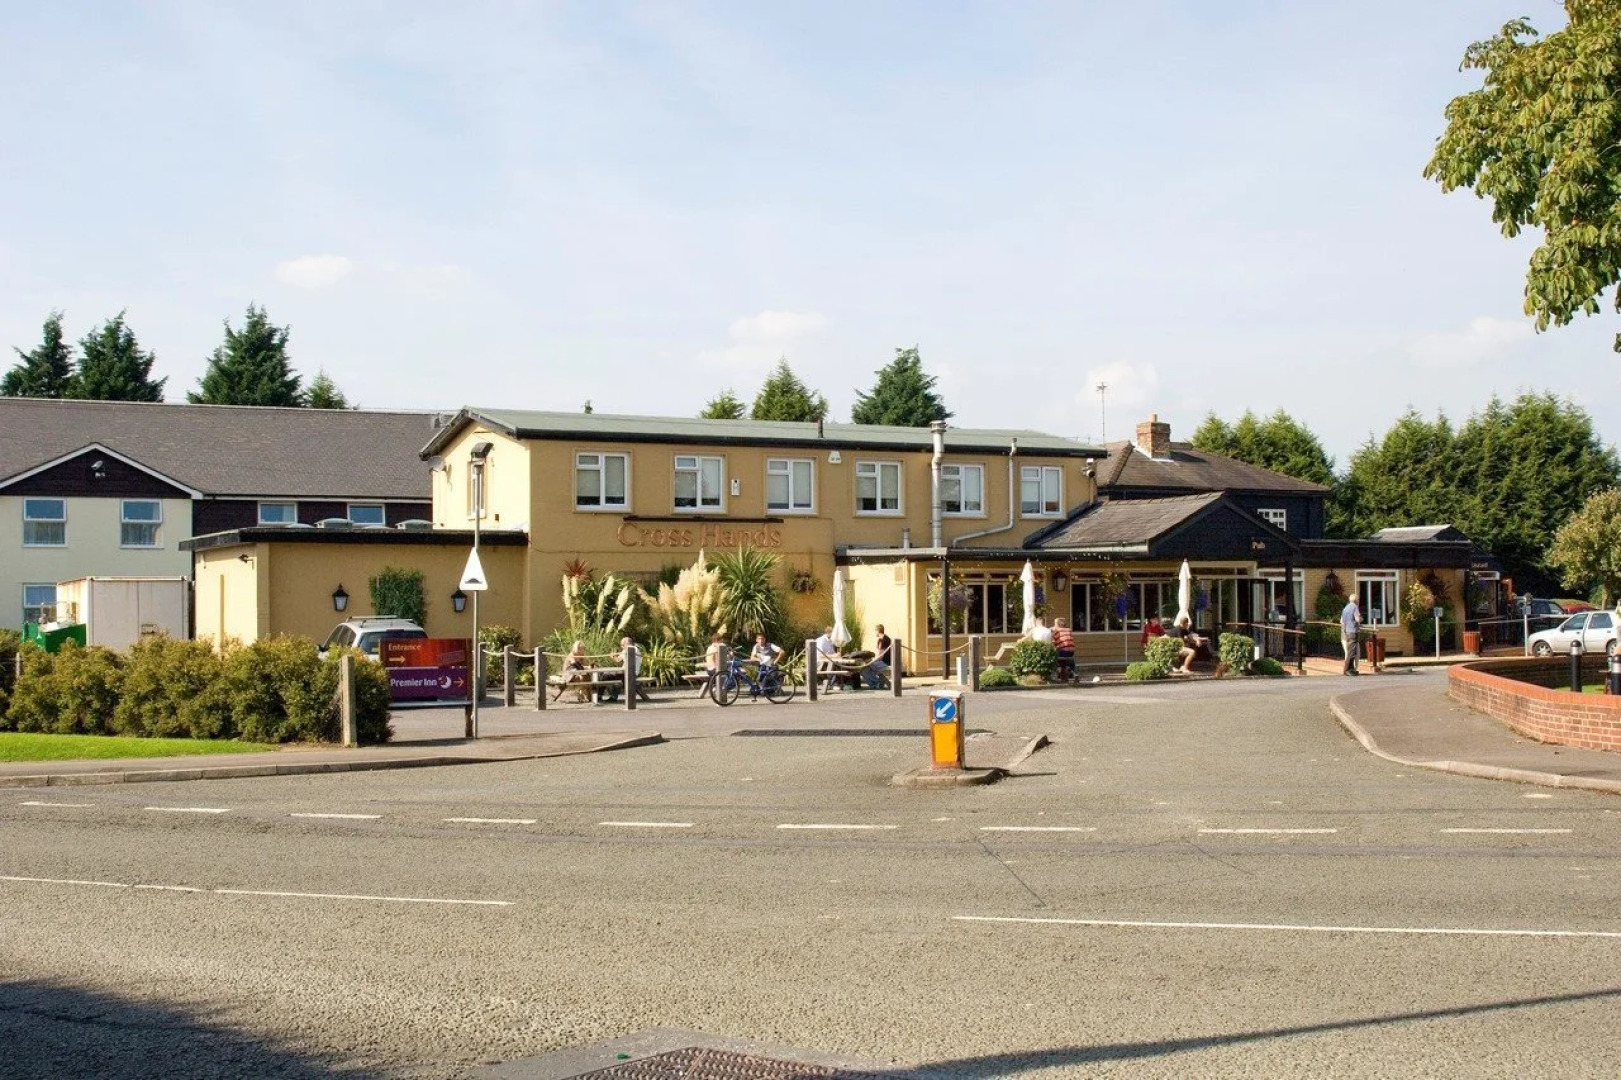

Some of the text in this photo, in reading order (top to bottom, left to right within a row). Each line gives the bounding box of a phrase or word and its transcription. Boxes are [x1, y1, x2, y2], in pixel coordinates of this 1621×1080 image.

[617, 522, 782, 549] Cross Hands
[388, 643, 421, 651] Entrance
[390, 678, 438, 687] Premier Inn
